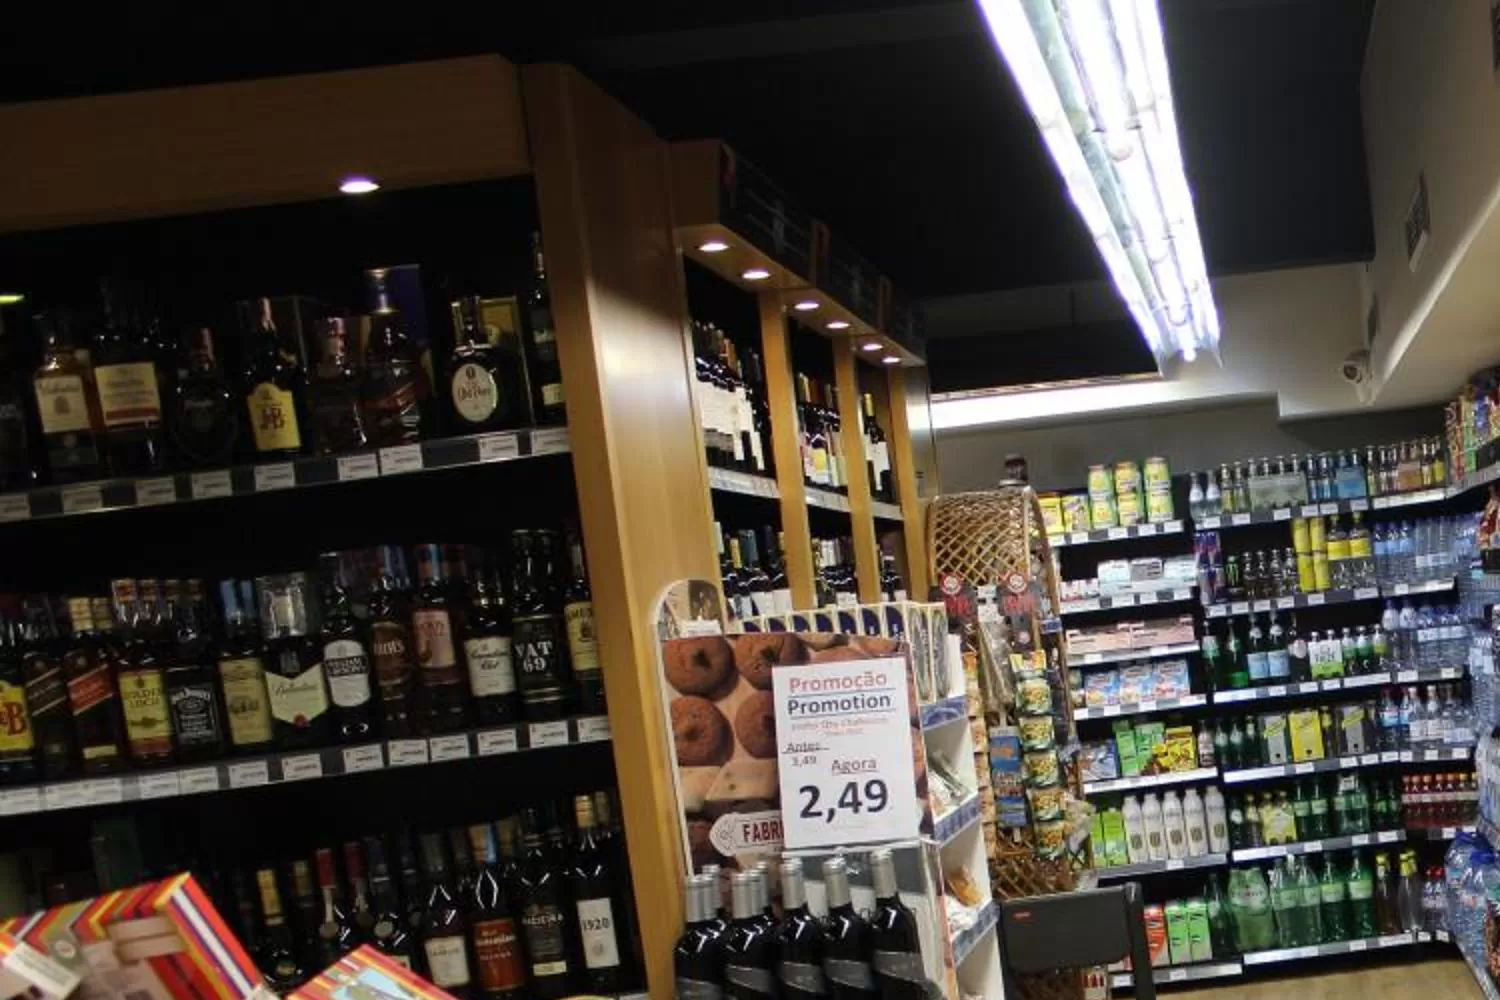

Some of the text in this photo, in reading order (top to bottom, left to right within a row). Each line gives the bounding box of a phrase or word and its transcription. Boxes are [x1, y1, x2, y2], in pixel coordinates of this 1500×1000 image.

[514, 642, 553, 657] VAT
[523, 658, 547, 672] 69
[788, 671, 888, 693] Promoção
[787, 694, 891, 716] Promotion
[831, 758, 878, 775] Agora
[800, 779, 889, 823] 2,49
